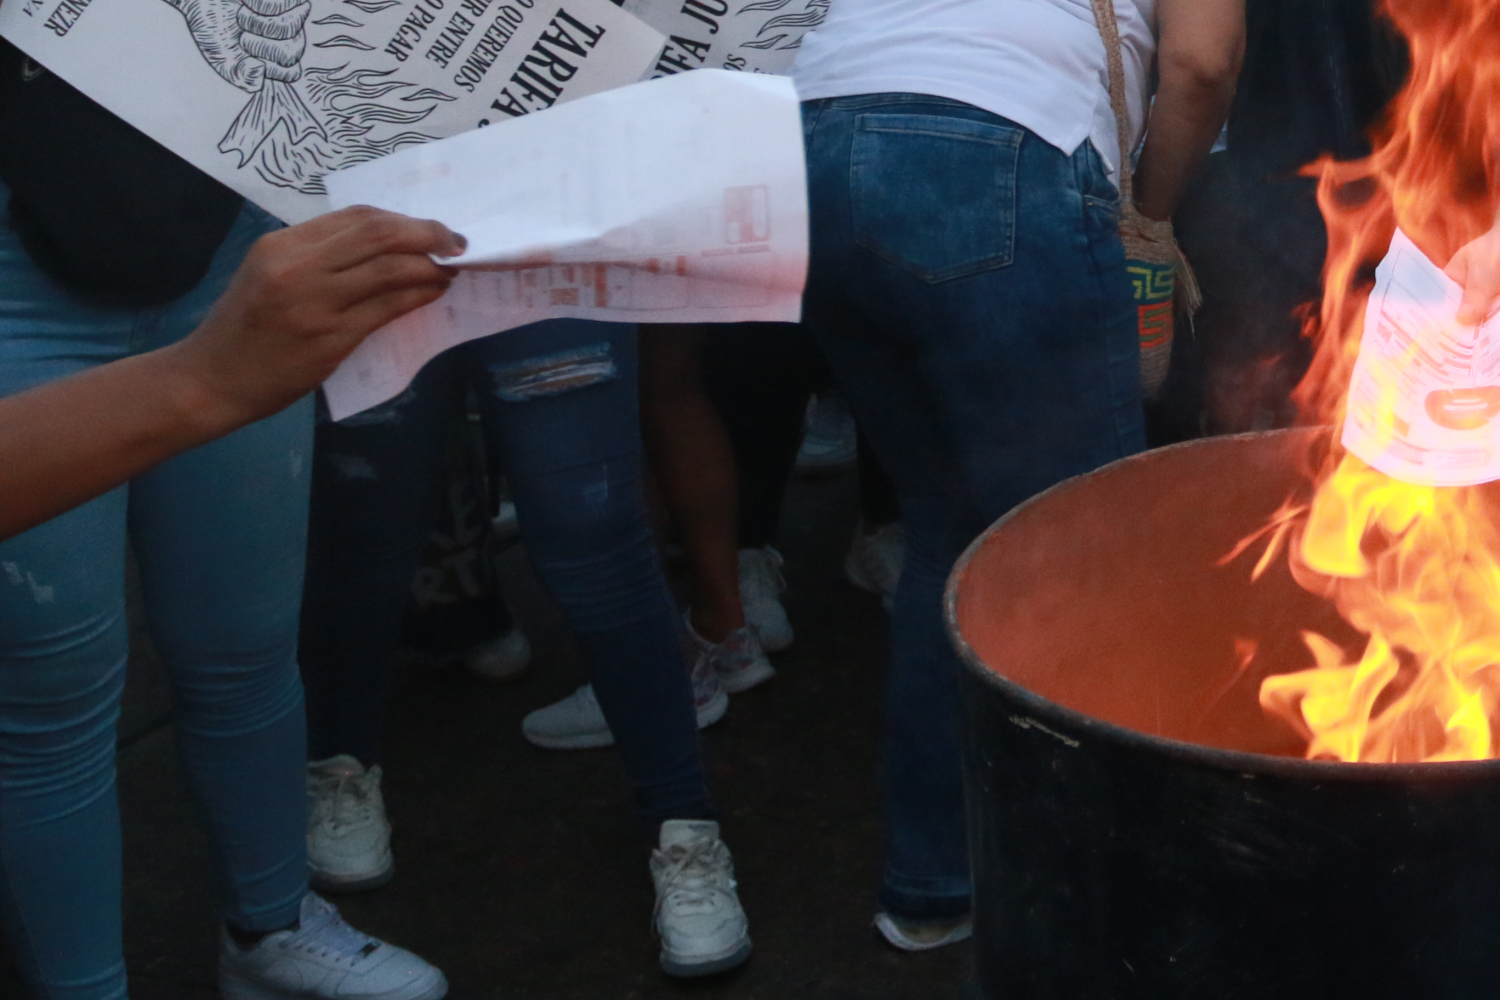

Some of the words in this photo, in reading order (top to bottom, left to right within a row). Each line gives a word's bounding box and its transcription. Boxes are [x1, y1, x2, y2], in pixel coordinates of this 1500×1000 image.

[384, 3, 436, 62] PAGAR
[425, 11, 475, 69] ENTRE
[453, 4, 524, 93] QUEREMOS
[491, 7, 606, 117] TARIFA
